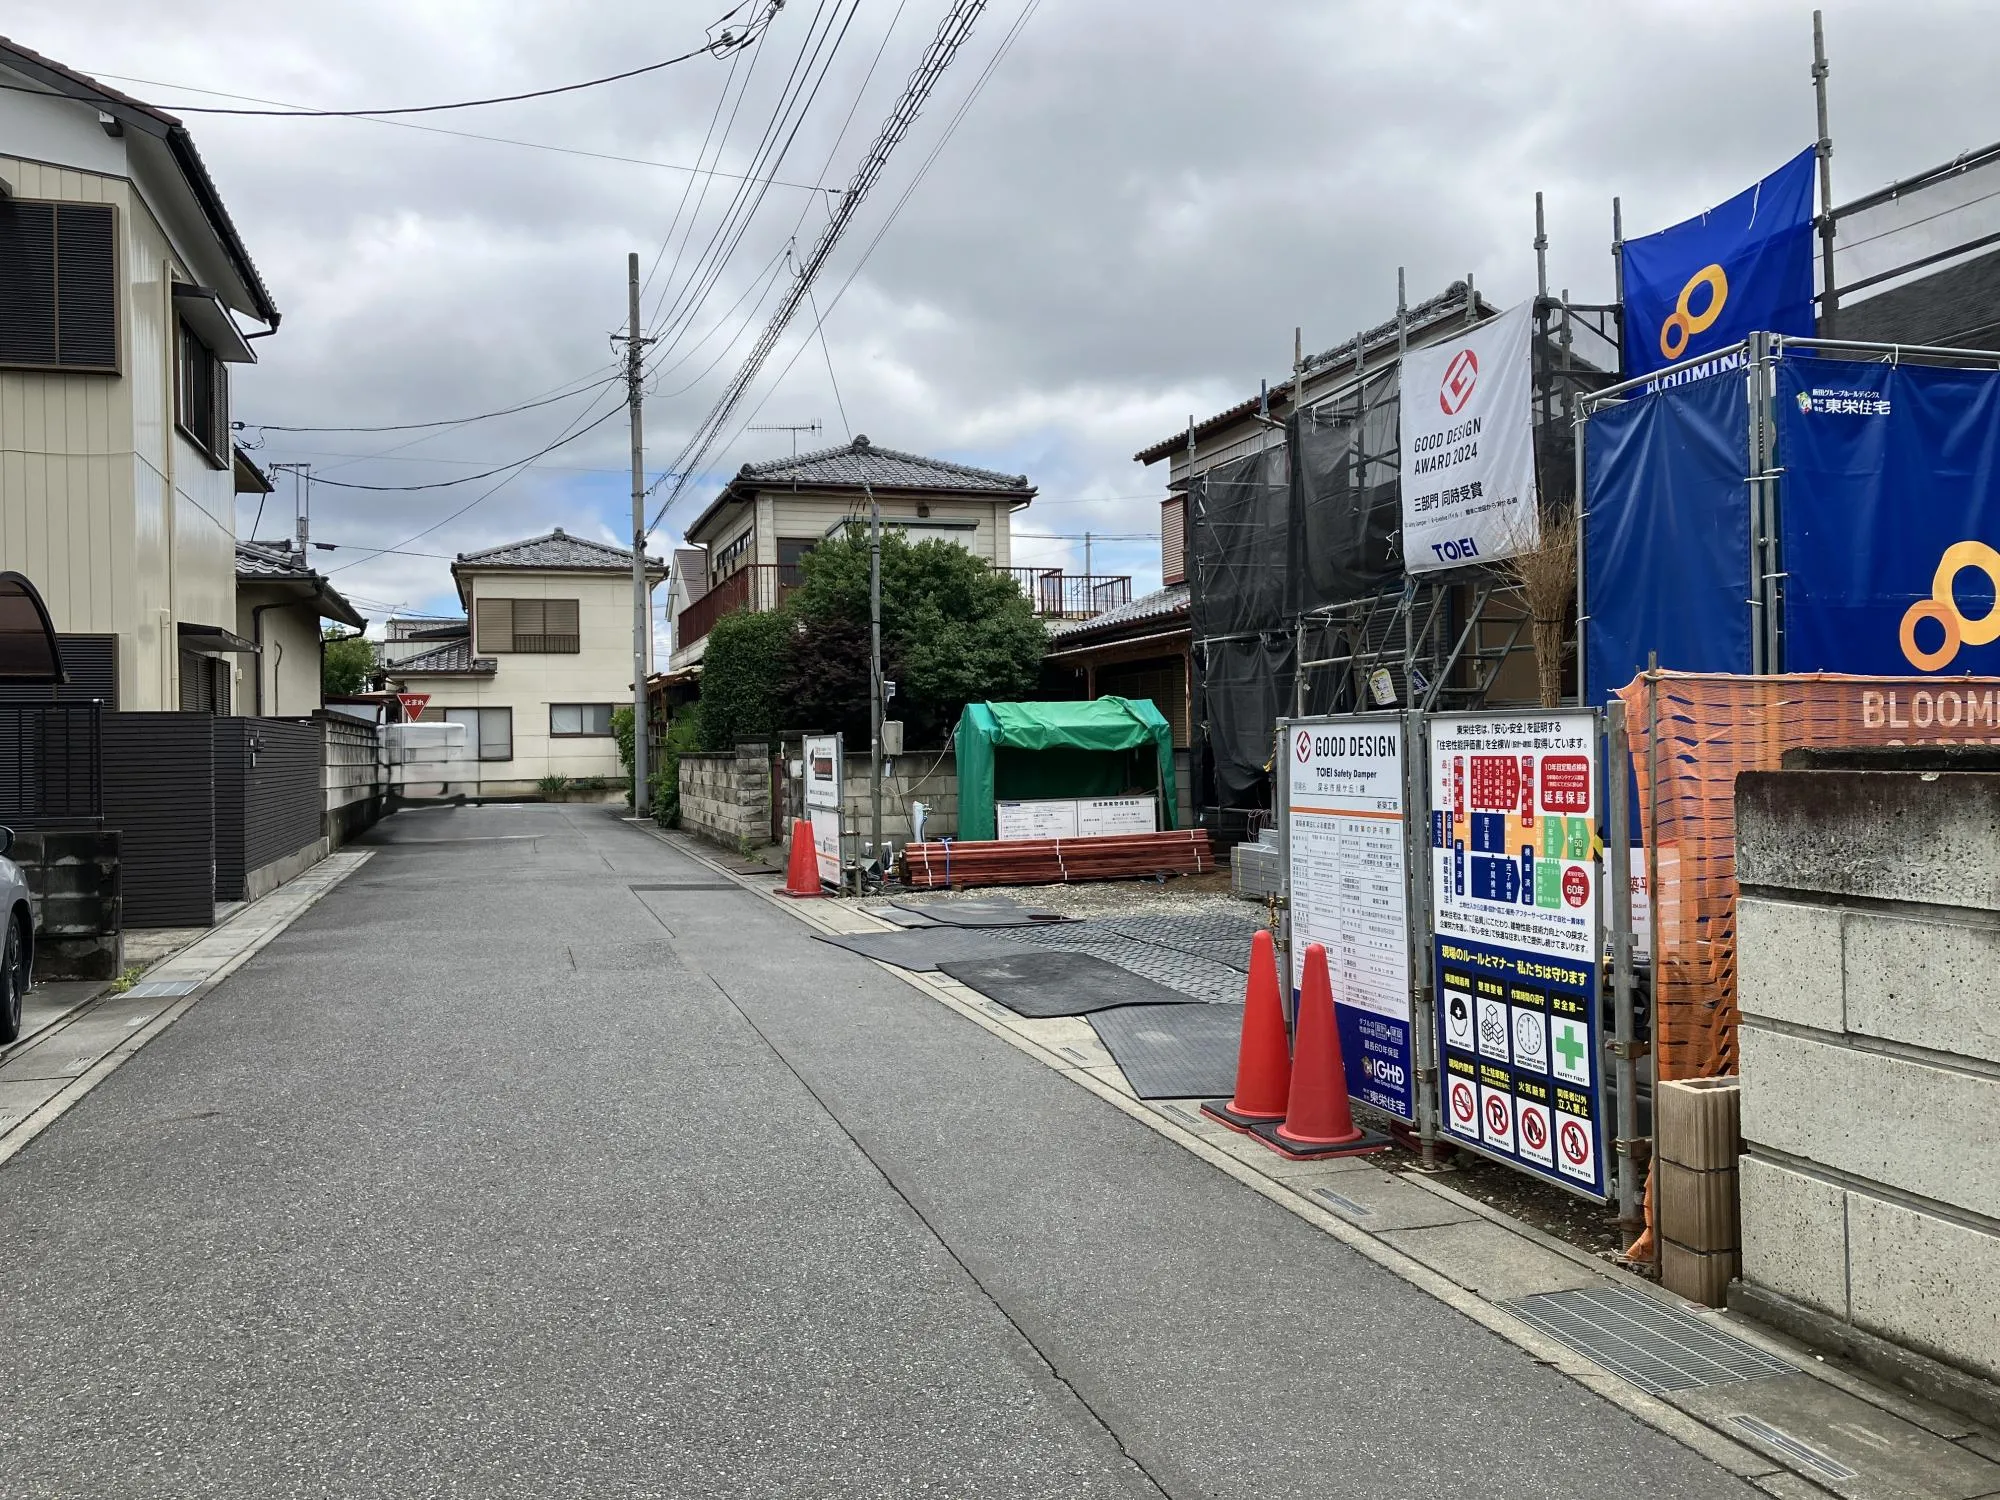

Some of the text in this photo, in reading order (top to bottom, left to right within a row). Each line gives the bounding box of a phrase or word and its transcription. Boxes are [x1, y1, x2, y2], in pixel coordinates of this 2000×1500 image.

[1825, 398, 1891, 415] 東栄住宅
[1414, 417, 1482, 453] GOOD DESIGN
[1414, 442, 1478, 475] AWARD 2024
[1414, 481, 1484, 513] 三部門 同時受賞
[1315, 735, 1396, 757] GOOD DESIGN
[1334, 769, 1352, 780] Safety
[1353, 769, 1377, 780] Damper
[1545, 763, 1587, 772] 10年目定期点検後
[1544, 790, 1587, 804] 延長保証
[1566, 885, 1585, 896] 60年
[1570, 896, 1582, 906] 保証
[1441, 945, 1587, 986] 現場のルールとマナー 私たちは守ります
[1553, 998, 1584, 1013] 安全第一
[1364, 1040, 1399, 1058] 最長60年保証
[1557, 1071, 1586, 1083] SAFETY FIRST
[1518, 1081, 1546, 1099] 火気厳禁
[1556, 1087, 1587, 1106] 関係者以外
[1370, 1091, 1406, 1114] 東栄住宅
[1558, 1098, 1589, 1117] 立入禁止
[1494, 1138, 1510, 1147] PARKING
[1526, 1150, 1536, 1158] OPEN
[1537, 1154, 1552, 1164] FLAMES
[1577, 1169, 1591, 1178] ENTER
